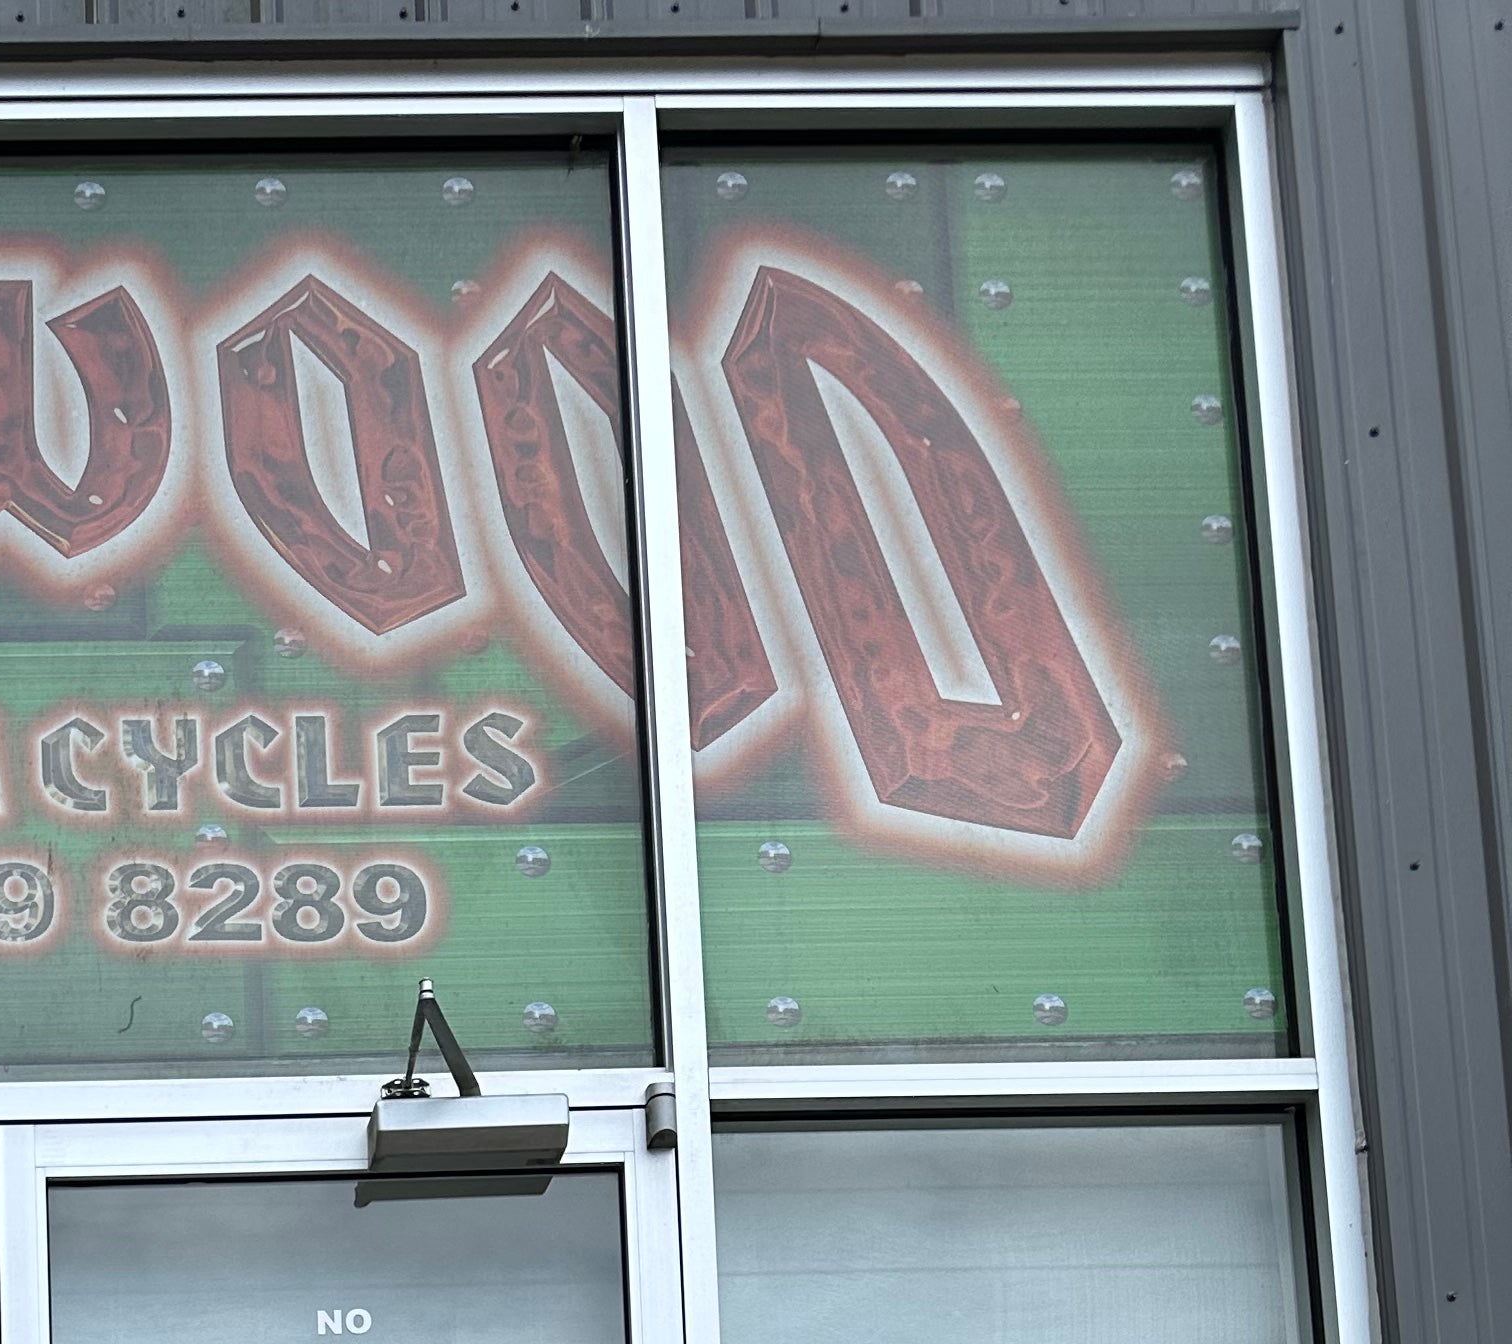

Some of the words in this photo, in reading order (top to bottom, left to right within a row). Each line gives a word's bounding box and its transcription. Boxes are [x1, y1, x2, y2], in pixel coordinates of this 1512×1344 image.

[40, 712, 535, 815] CYCLES
[107, 860, 429, 943] 8289
[317, 1308, 372, 1335] NO
